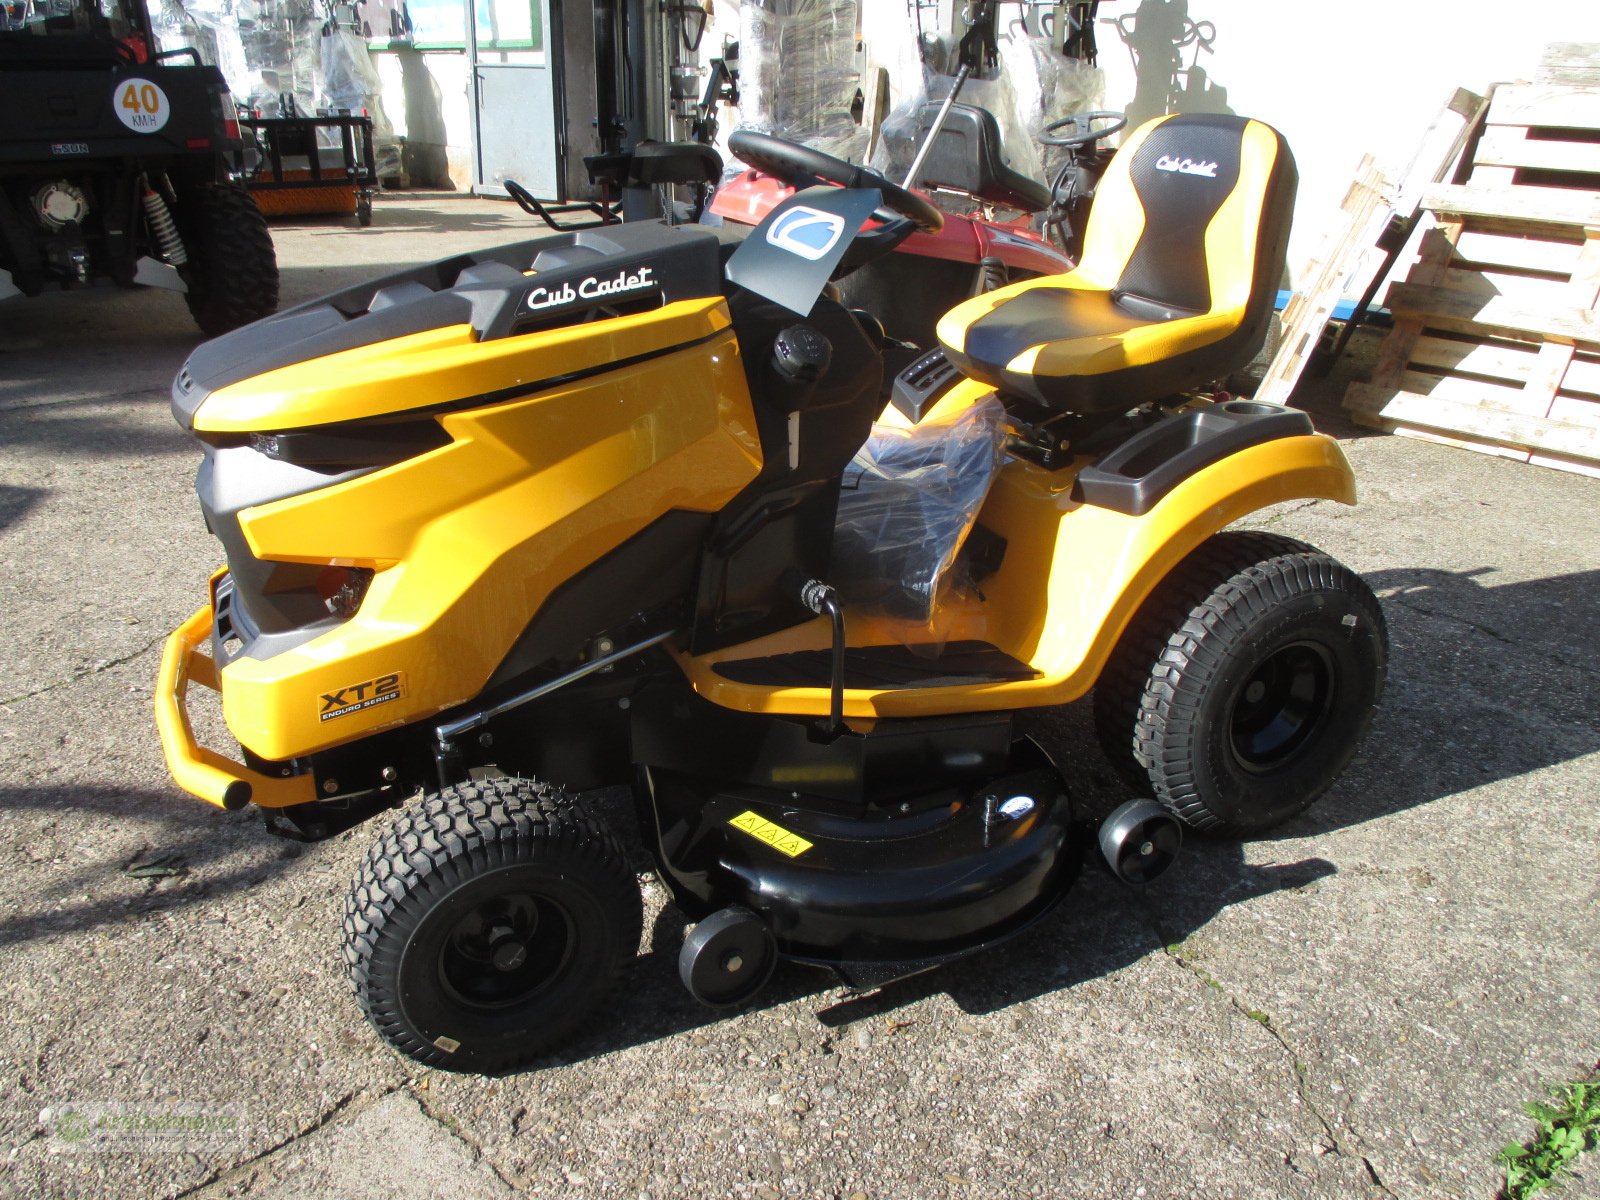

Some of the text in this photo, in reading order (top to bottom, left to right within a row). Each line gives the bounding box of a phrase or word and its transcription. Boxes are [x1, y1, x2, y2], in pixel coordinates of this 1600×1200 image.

[122, 84, 160, 114] 40
[132, 115, 157, 127] KM/H
[1155, 155, 1218, 177] Cub Cadet
[527, 267, 654, 310] Cub Cadet
[320, 674, 400, 712] XT2
[322, 691, 397, 720] ENDURO SERIES
